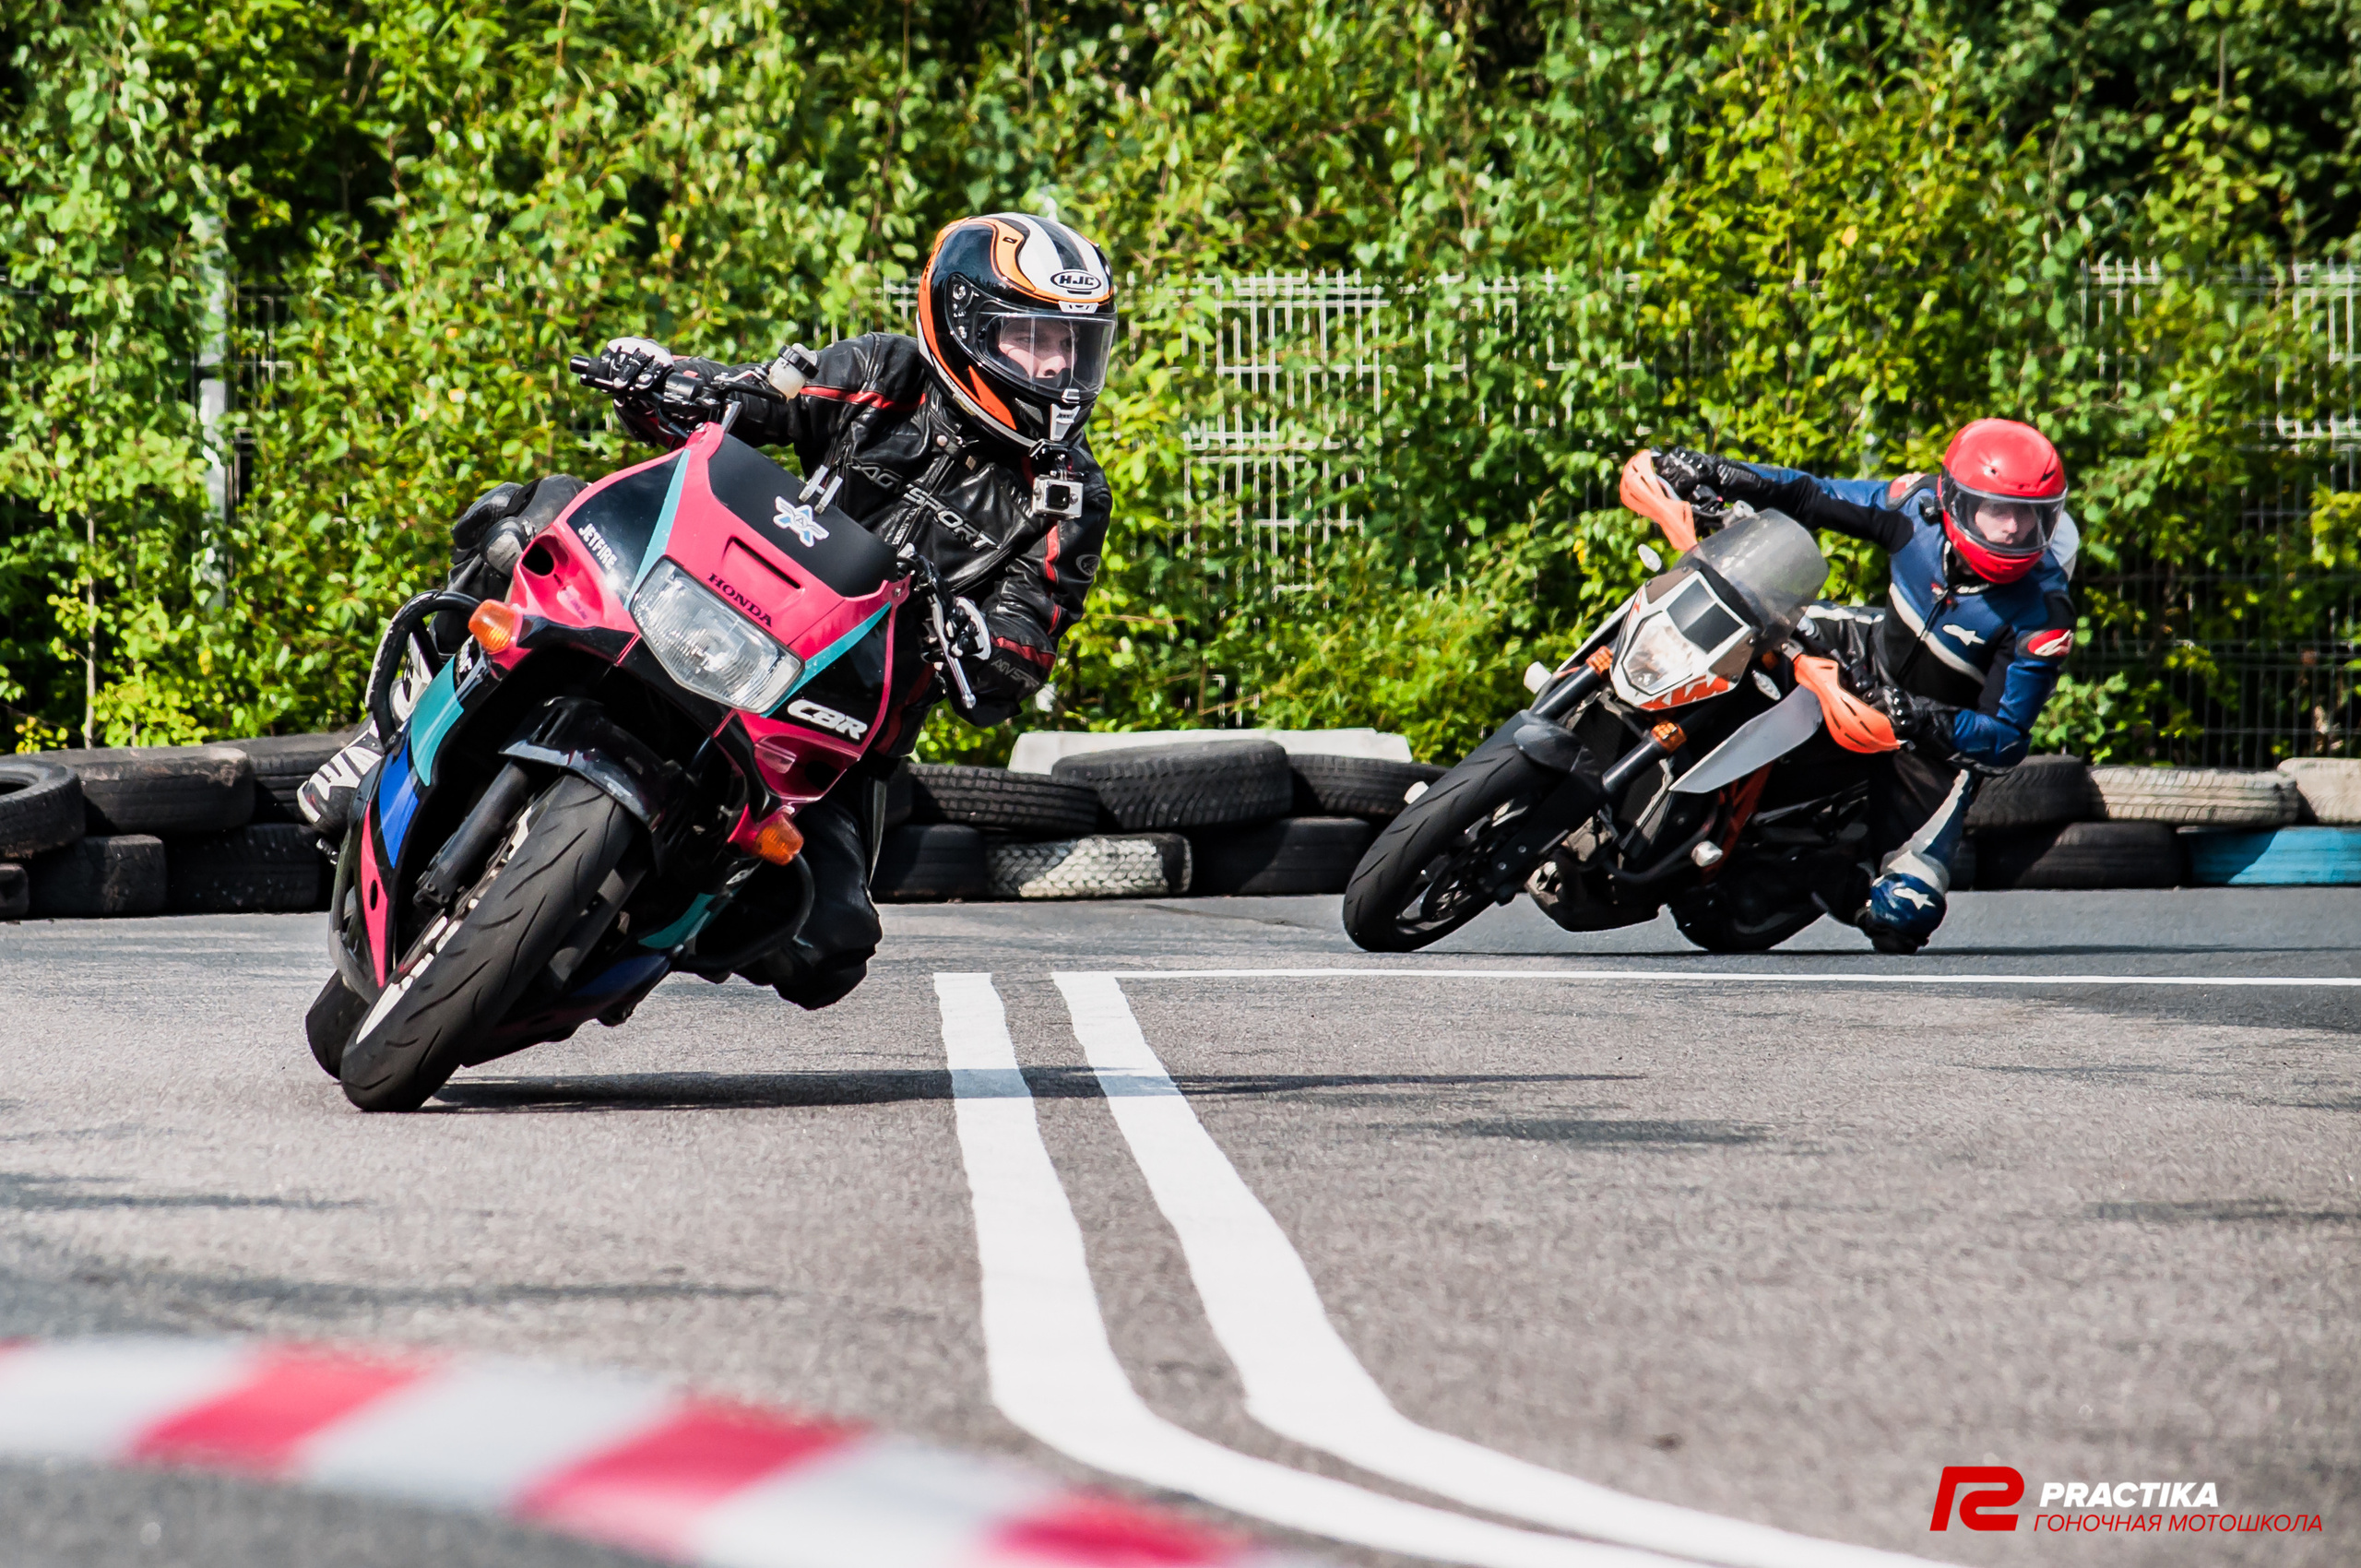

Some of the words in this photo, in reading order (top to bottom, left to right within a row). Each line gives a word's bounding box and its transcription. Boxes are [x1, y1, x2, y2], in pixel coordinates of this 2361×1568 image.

[1060, 275, 1095, 286] HJC
[902, 482, 1003, 552] SPORT
[578, 523, 618, 570] JETFIRE
[708, 573, 772, 628] HONDA
[787, 698, 868, 741] CBR
